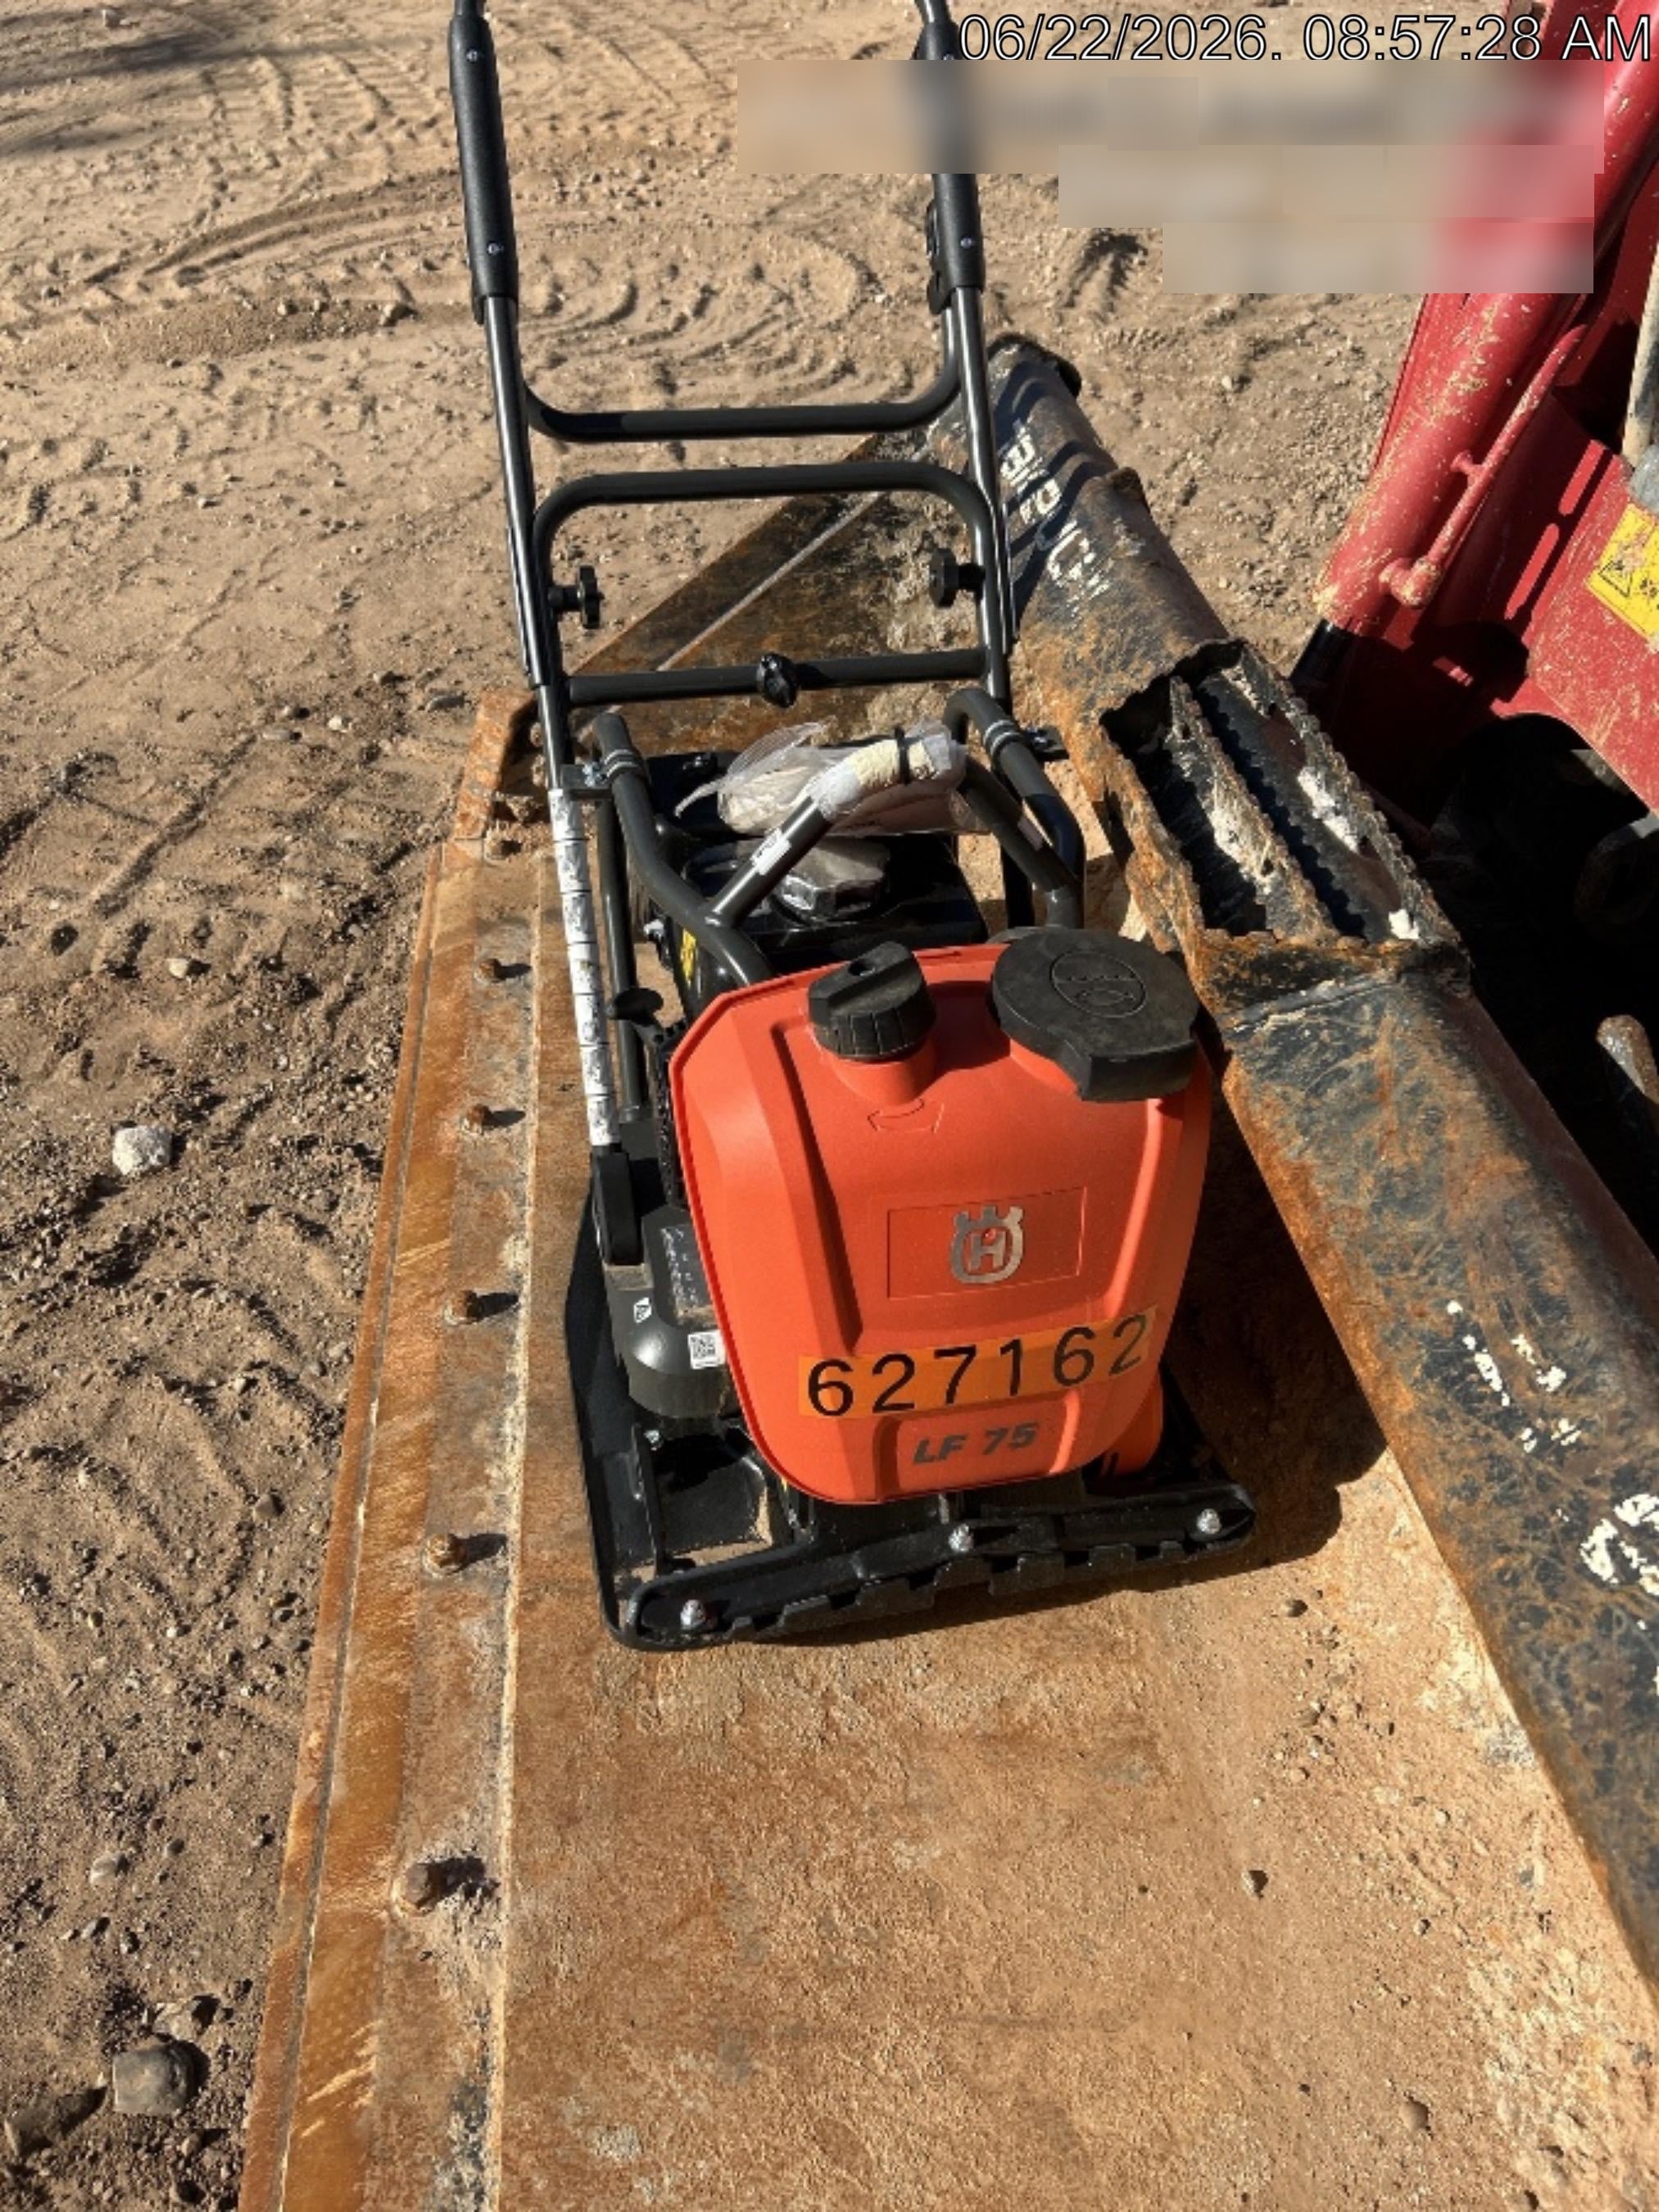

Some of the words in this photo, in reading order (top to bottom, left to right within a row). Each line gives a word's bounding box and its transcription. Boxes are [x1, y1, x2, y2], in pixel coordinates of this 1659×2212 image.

[808, 1313, 1147, 1417] 627162
[913, 1433, 967, 1465] LF
[981, 1421, 1039, 1456] 75
